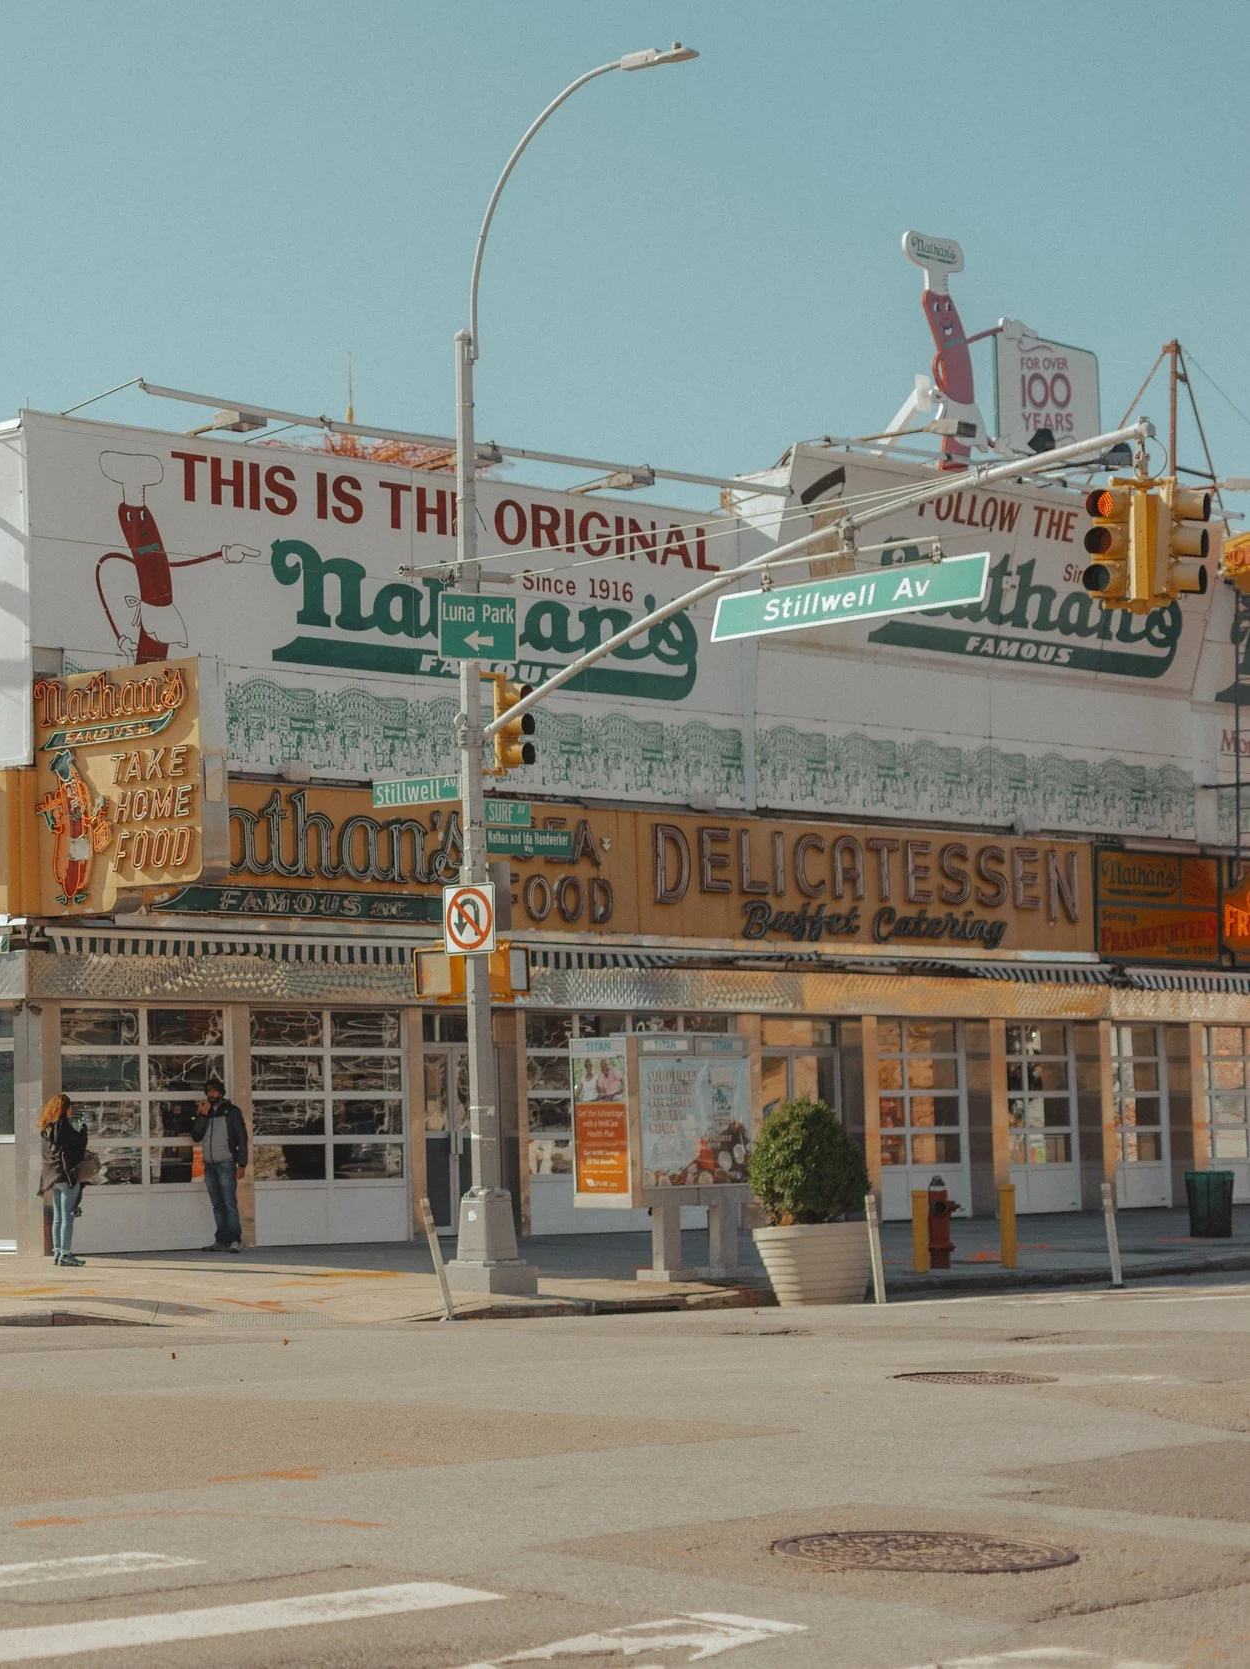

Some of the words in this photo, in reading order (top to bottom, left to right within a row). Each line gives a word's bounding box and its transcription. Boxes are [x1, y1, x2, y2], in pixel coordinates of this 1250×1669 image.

[910, 235, 957, 261] Nathan's
[1020, 357, 1040, 371] FOR
[1042, 357, 1069, 371] OVER
[1021, 372, 1072, 409] 100
[1021, 412, 1074, 433] YEARS
[171, 451, 297, 516] THIS
[316, 472, 364, 525] IS
[379, 482, 457, 537] TH
[494, 498, 721, 572] ORIGINAL
[1034, 505, 1079, 542] THE
[522, 569, 577, 597] Since
[589, 577, 634, 603] 1916
[763, 582, 876, 621] Stillwell
[892, 576, 931, 601] Av
[442, 601, 475, 624] Luna
[482, 603, 514, 625] Park
[965, 635, 1074, 665] FAMOUS
[34, 667, 187, 728] Nathan's
[111, 744, 188, 785] TAKE
[113, 784, 194, 824] HOME
[376, 779, 440, 805] Stillwell
[443, 777, 457, 789] AV
[489, 803, 514, 823] SURF
[517, 804, 526, 816] AV
[112, 825, 192, 872] FOOD
[488, 830, 509, 845] Nathan
[510, 832, 522, 846] and
[523, 832, 532, 846] Ida
[534, 832, 569, 846] Handwerker
[524, 846, 534, 854] Way
[654, 822, 1080, 925] DELICATESSEN
[1102, 861, 1176, 889] Nathan's
[218, 889, 362, 917] FAMOUS
[742, 899, 861, 940] Buffet
[871, 904, 1009, 949] Catering
[1101, 910, 1138, 925] Serving
[1101, 917, 1218, 952] FRANKFURTERS
[585, 1041, 611, 1051] TITAN
[654, 1040, 677, 1050] TITAN
[712, 1040, 733, 1051] TITAN
